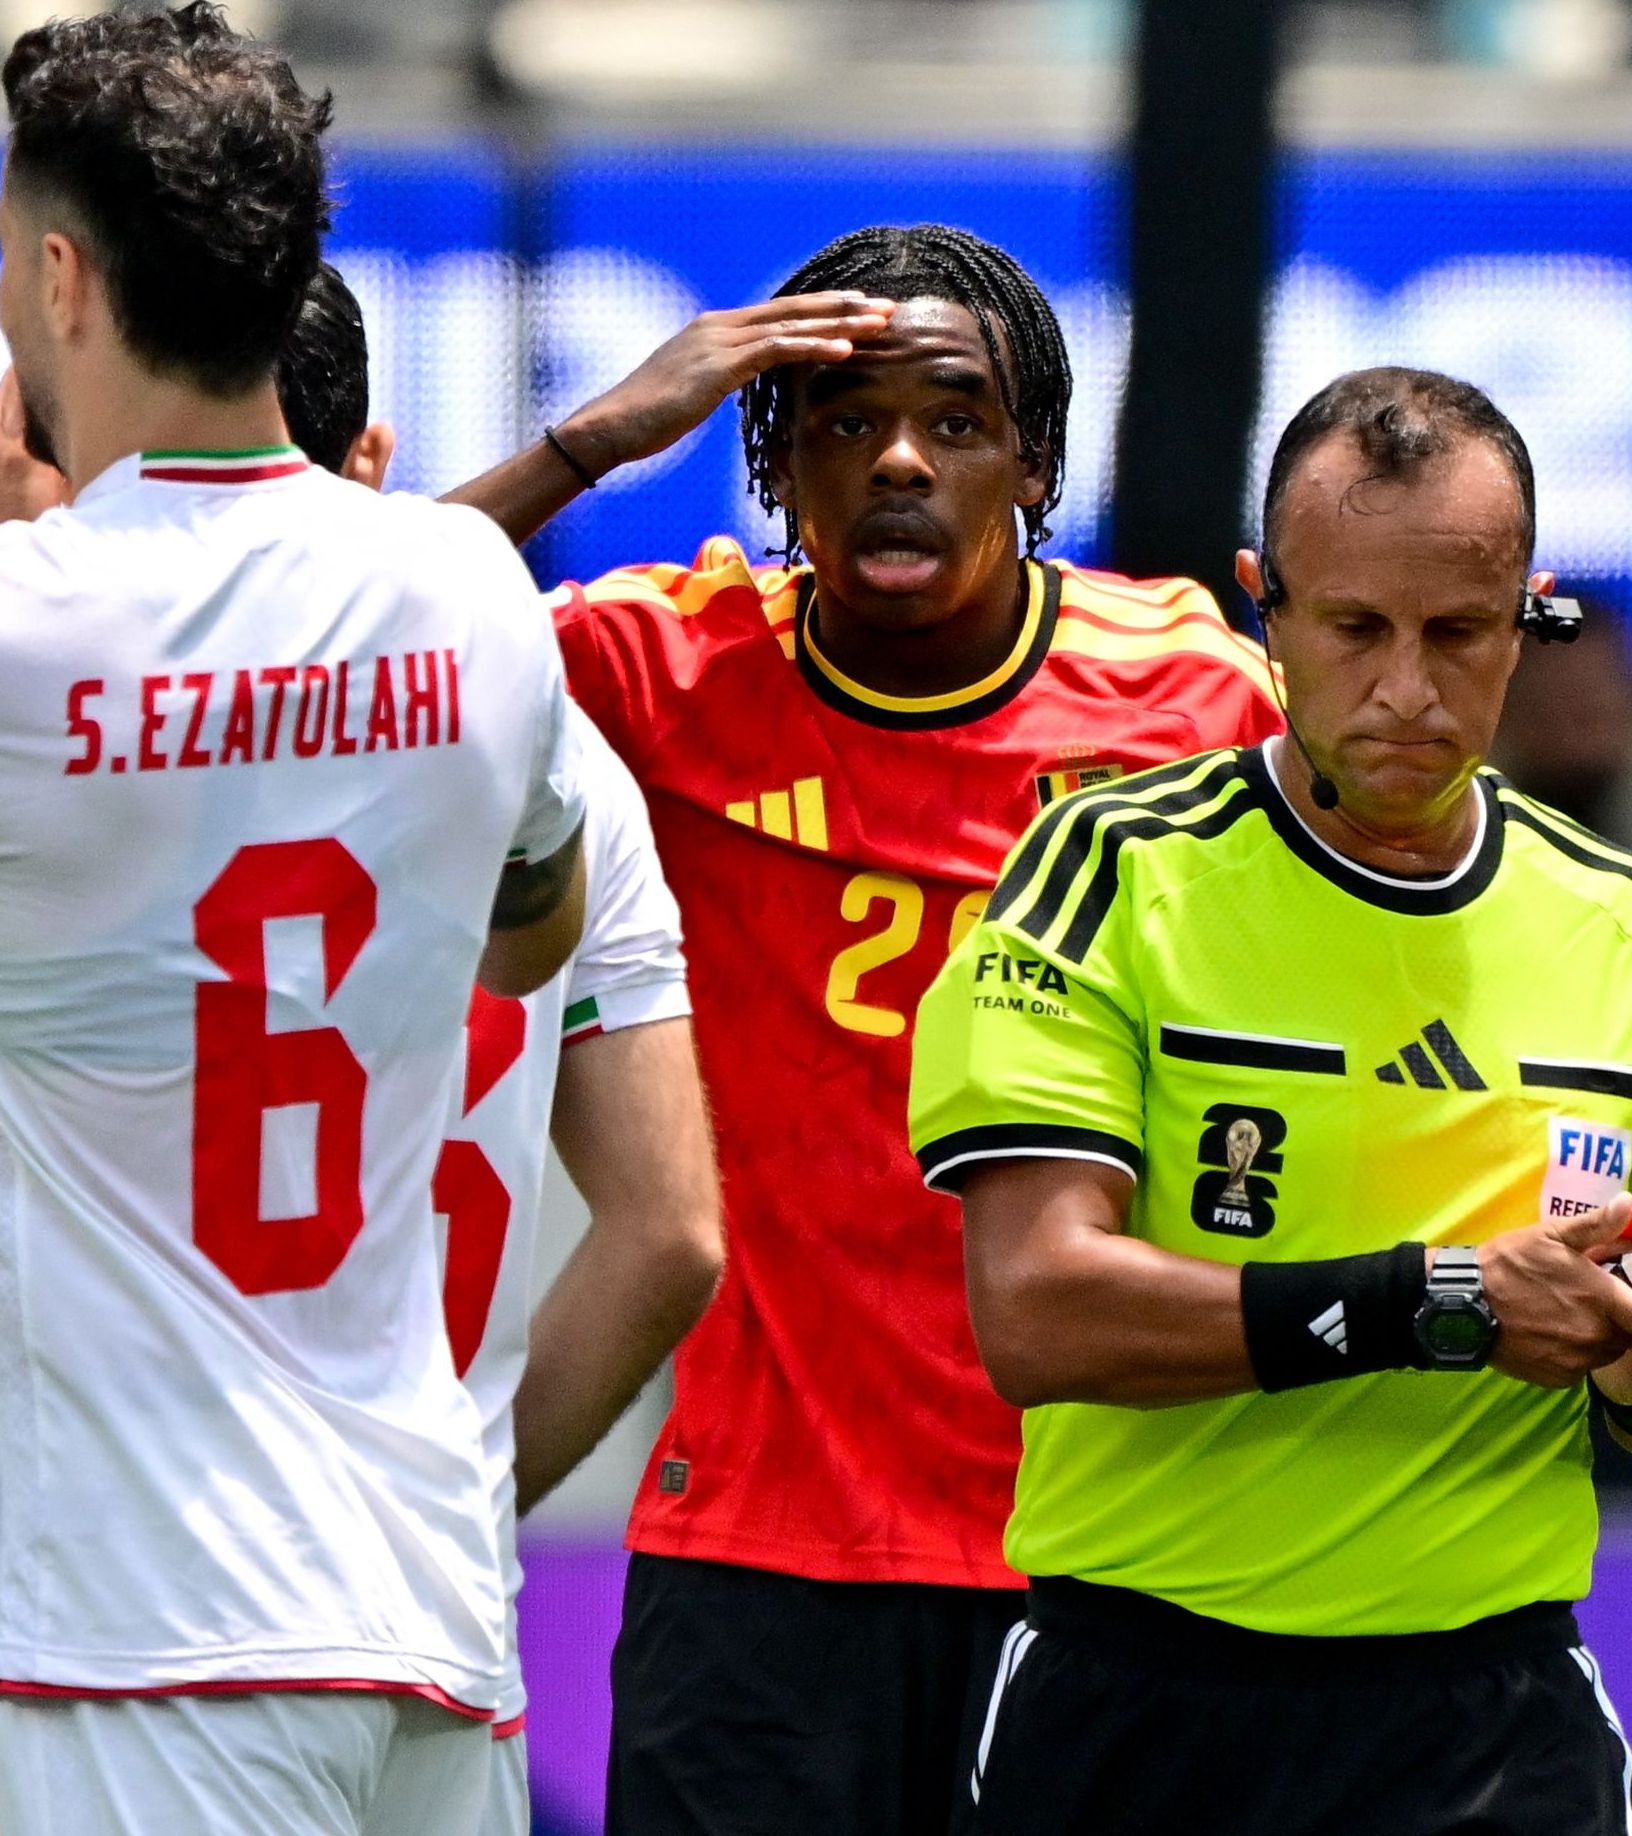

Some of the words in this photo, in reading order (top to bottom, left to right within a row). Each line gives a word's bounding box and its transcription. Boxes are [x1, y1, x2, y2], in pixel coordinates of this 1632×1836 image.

[65, 649, 461, 776] S.EZATOLAHI
[975, 952, 1069, 996] FIFA
[973, 996, 1024, 1012] TEAM
[1030, 1000, 1071, 1018] ONE
[191, 836, 378, 1297] 6
[1559, 1128, 1624, 1180] FIFA
[1213, 1207, 1253, 1228] FIFA
